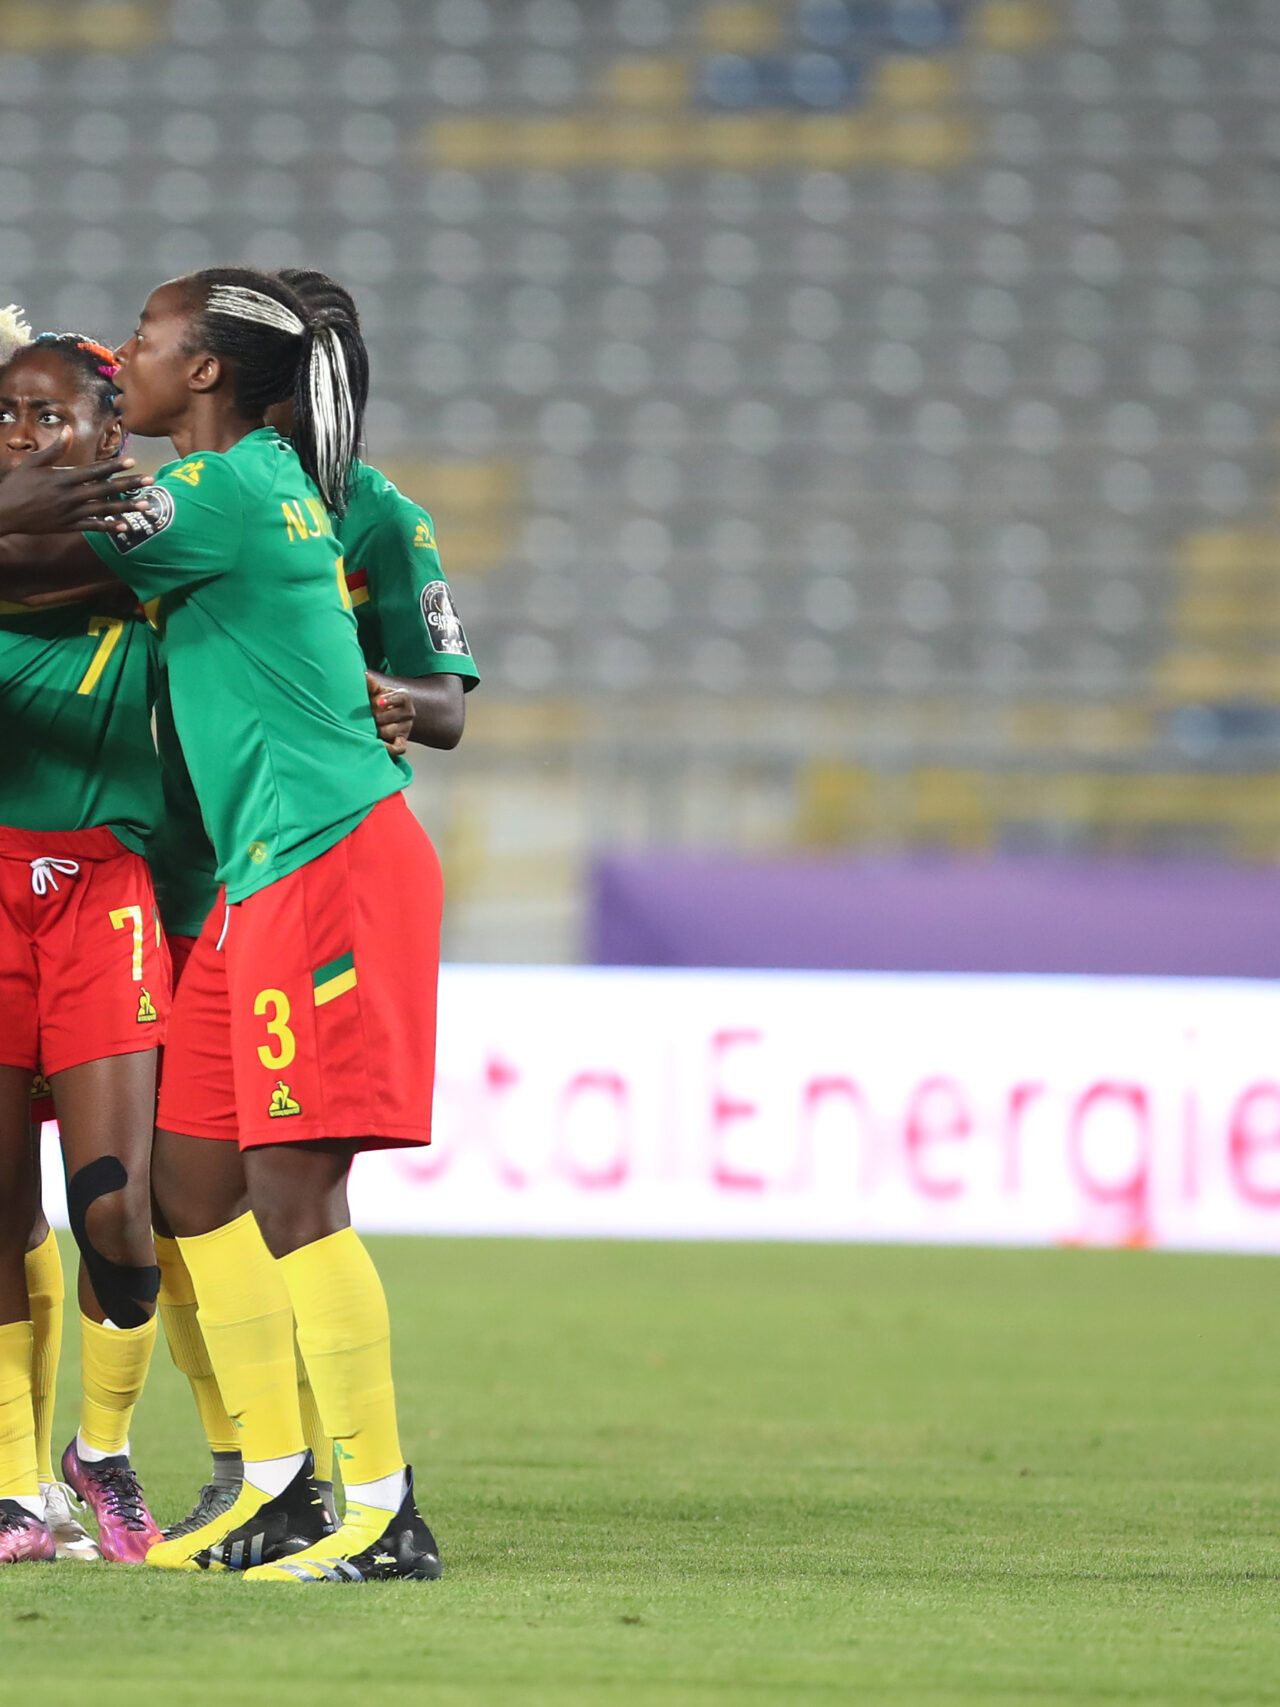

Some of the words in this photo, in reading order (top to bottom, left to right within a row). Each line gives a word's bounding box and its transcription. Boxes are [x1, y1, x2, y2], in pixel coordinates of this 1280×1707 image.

[77, 616, 124, 695] 7
[108, 905, 143, 981] 7
[253, 988, 296, 1070] 3
